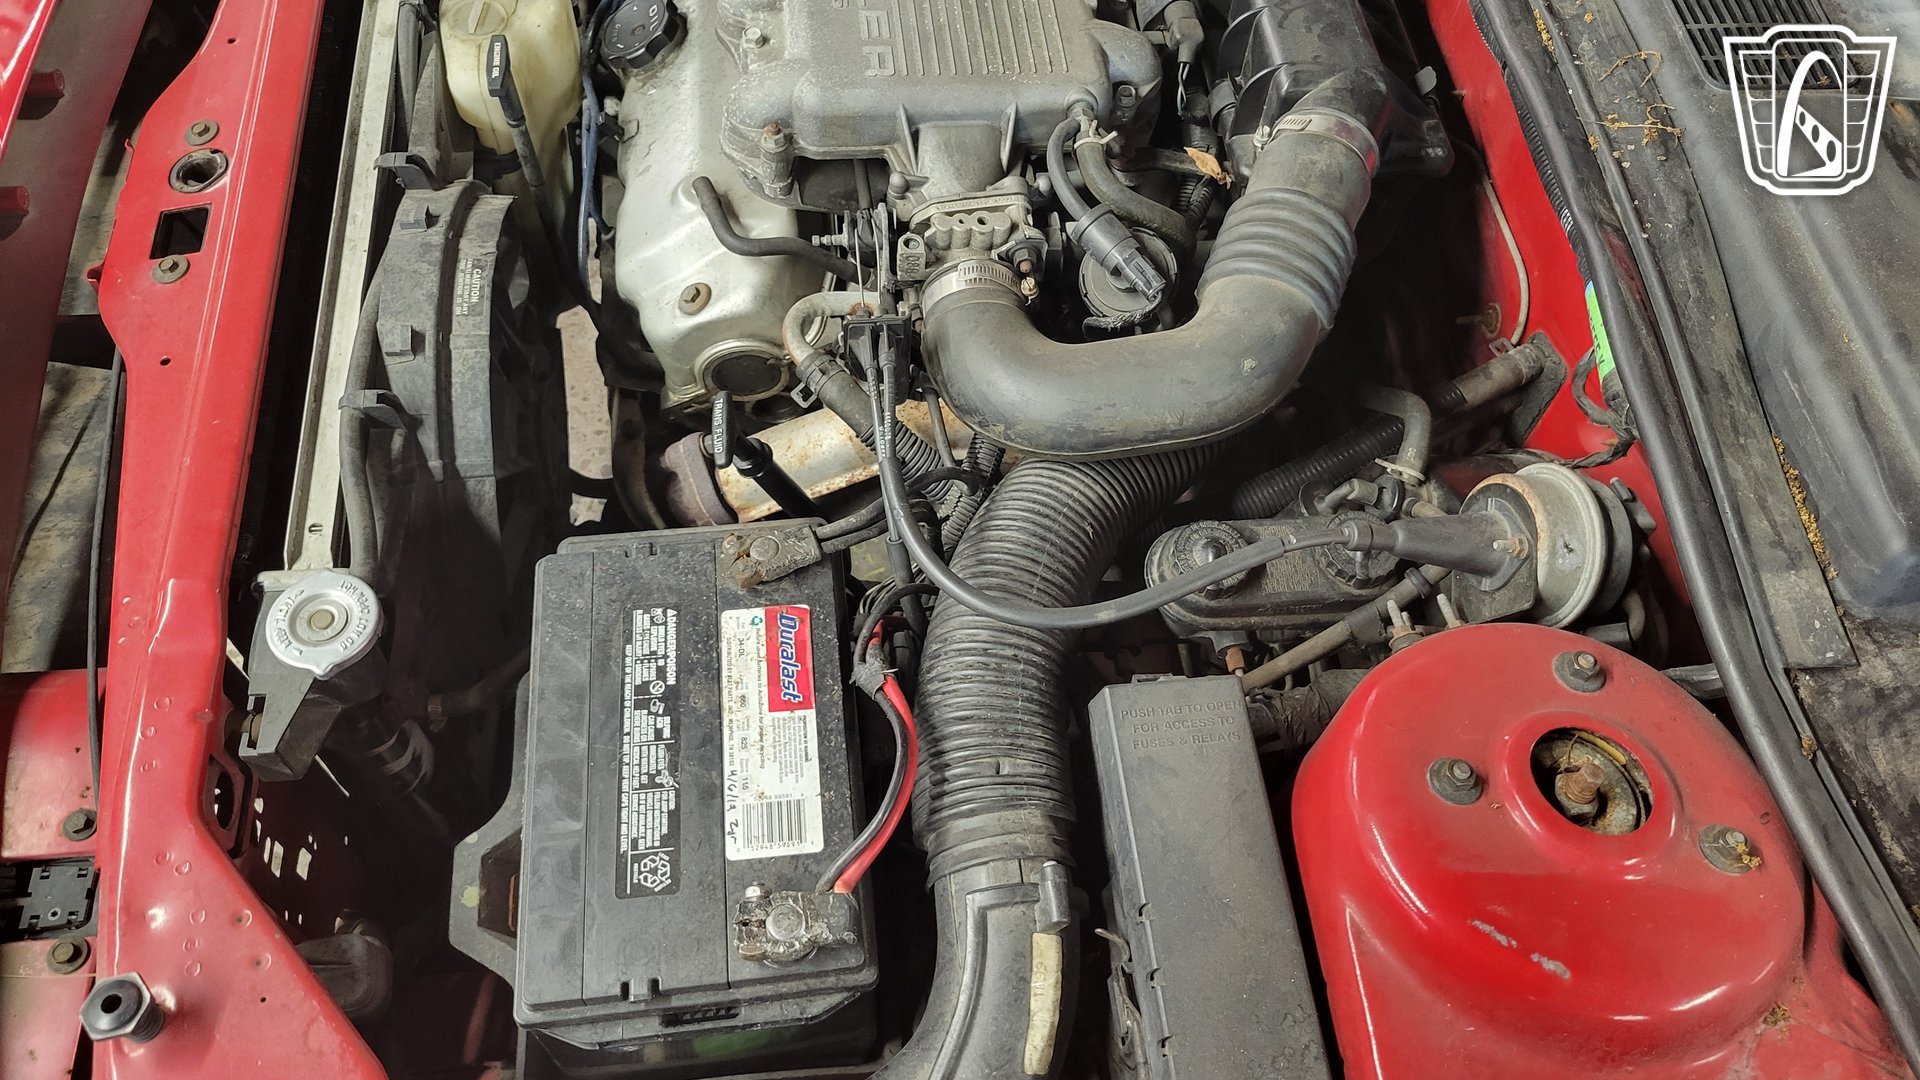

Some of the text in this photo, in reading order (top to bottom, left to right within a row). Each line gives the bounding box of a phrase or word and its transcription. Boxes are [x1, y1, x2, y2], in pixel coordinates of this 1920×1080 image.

[649, 4, 659, 32] OIL
[857, 0, 896, 78] ER
[471, 269, 481, 302] CAUTION
[714, 398, 723, 454] TRANS FLUID
[778, 613, 803, 703] Duralast
[1120, 700, 1241, 720] PUSH TAB TO OPEN
[1132, 716, 1235, 733] FOR ACCESS TO
[1132, 738, 1174, 749] FUSES
[1191, 731, 1241, 744] RELAYS
